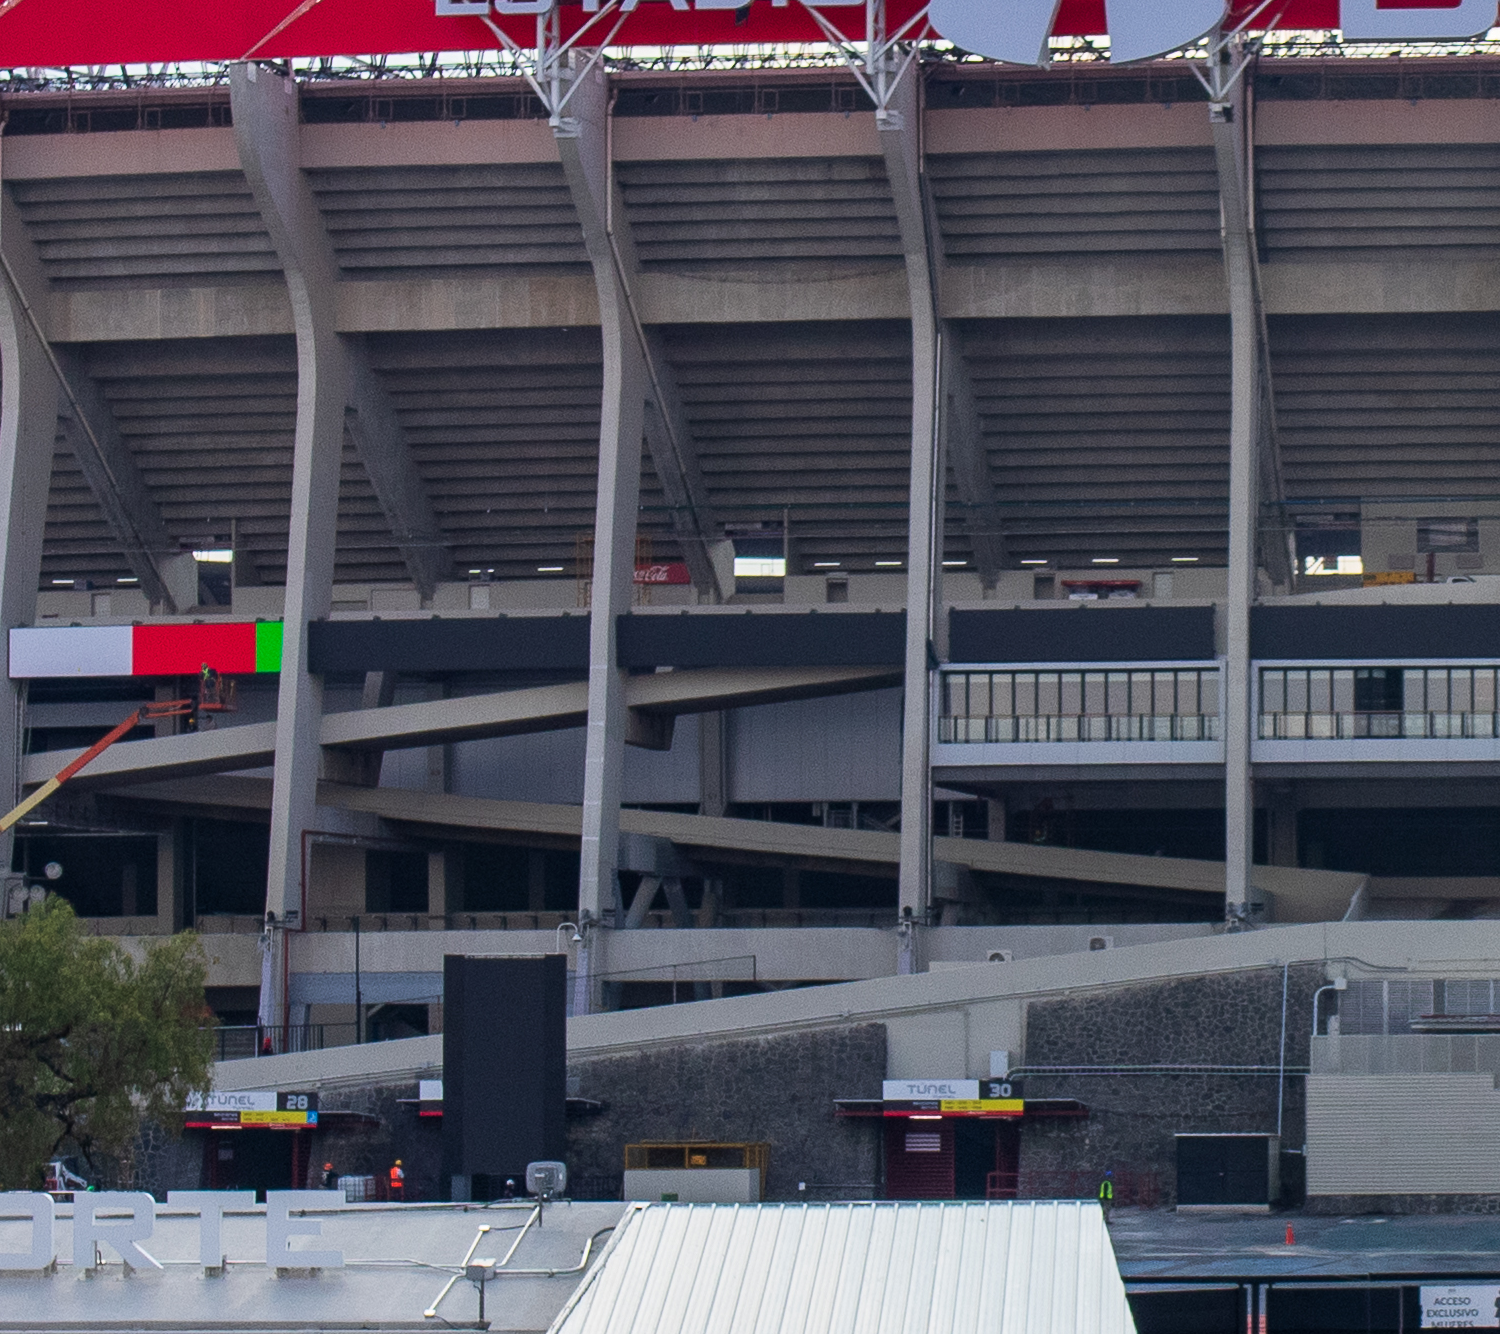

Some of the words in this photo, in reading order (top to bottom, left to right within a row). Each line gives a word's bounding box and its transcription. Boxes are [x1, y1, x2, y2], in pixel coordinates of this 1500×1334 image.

[906, 1082, 956, 1095] TÚNEL
[989, 1083, 1012, 1097] 30
[208, 1093, 255, 1106] TÚNEL
[286, 1094, 308, 1110] 28
[1433, 1297, 1472, 1306] ACCESO
[1426, 1308, 1479, 1318] EXCLUSIVO
